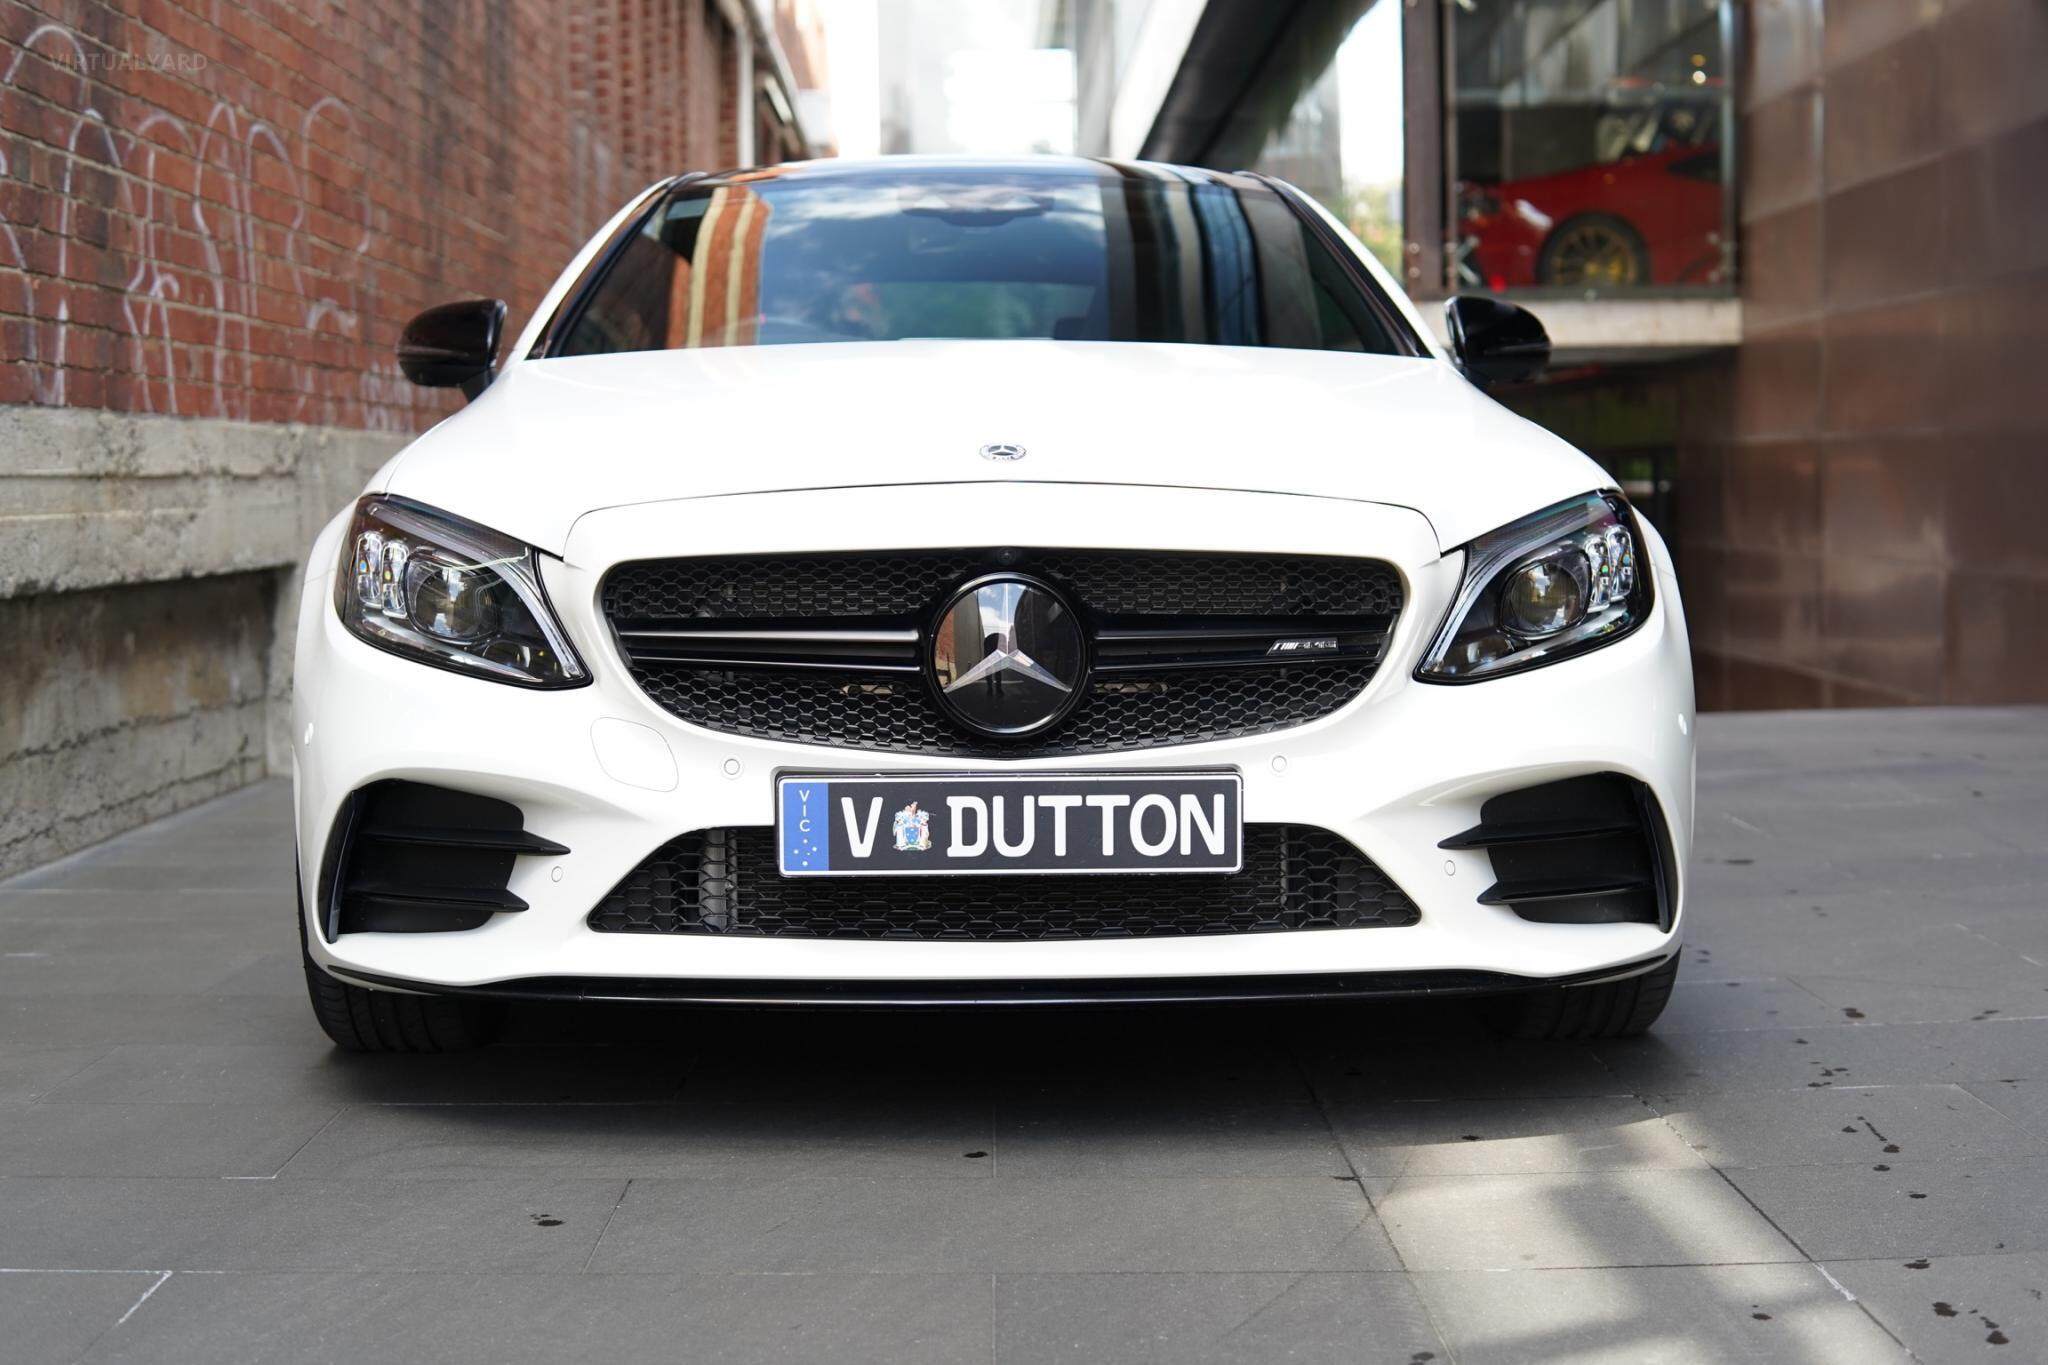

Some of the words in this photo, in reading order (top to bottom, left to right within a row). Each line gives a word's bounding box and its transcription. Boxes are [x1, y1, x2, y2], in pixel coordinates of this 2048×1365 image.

[799, 790, 811, 832] VIC
[840, 796, 883, 858] V
[946, 794, 1225, 858] DUTTON
